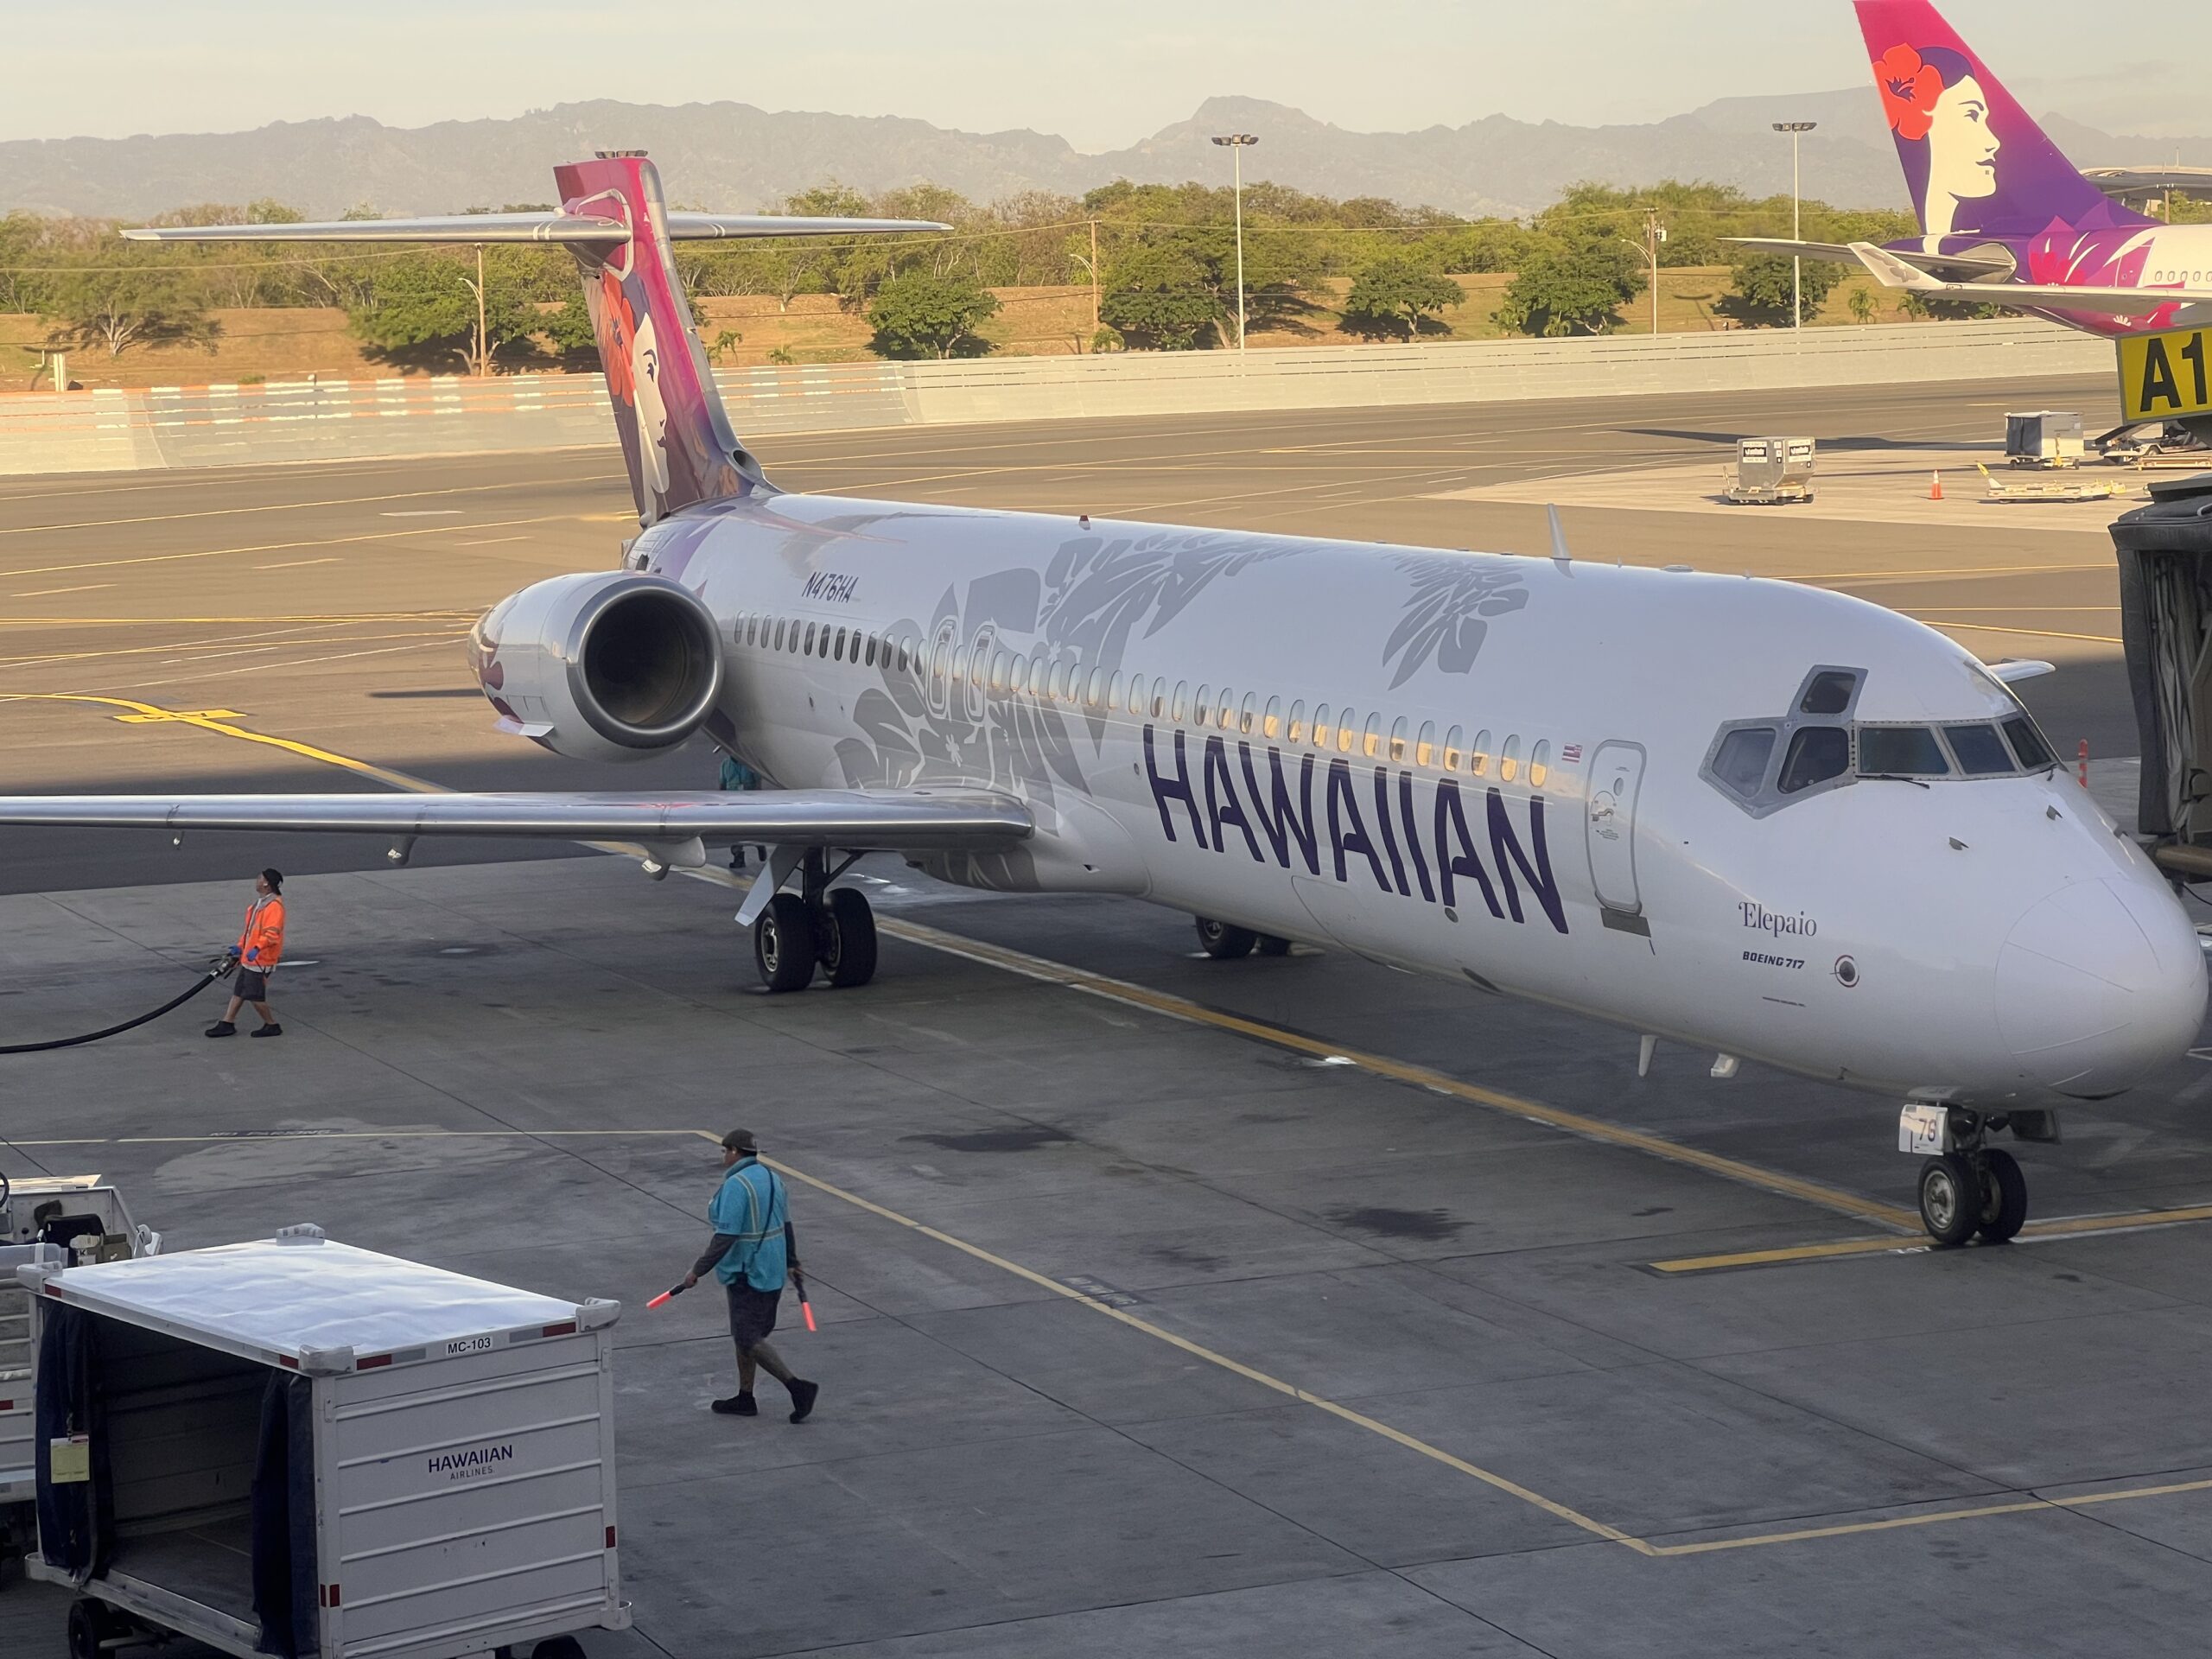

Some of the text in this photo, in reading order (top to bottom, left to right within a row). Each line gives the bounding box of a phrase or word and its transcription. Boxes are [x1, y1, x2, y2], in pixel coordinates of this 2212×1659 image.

[801, 571, 859, 603] N476HA
[1143, 724, 1568, 934] HAWAIIAN
[1742, 950, 1805, 969] BOEING 717
[448, 1337, 491, 1354] MC-103
[429, 1445, 512, 1472] HAWAIIAN
[450, 1465, 495, 1480] AIRLINES
